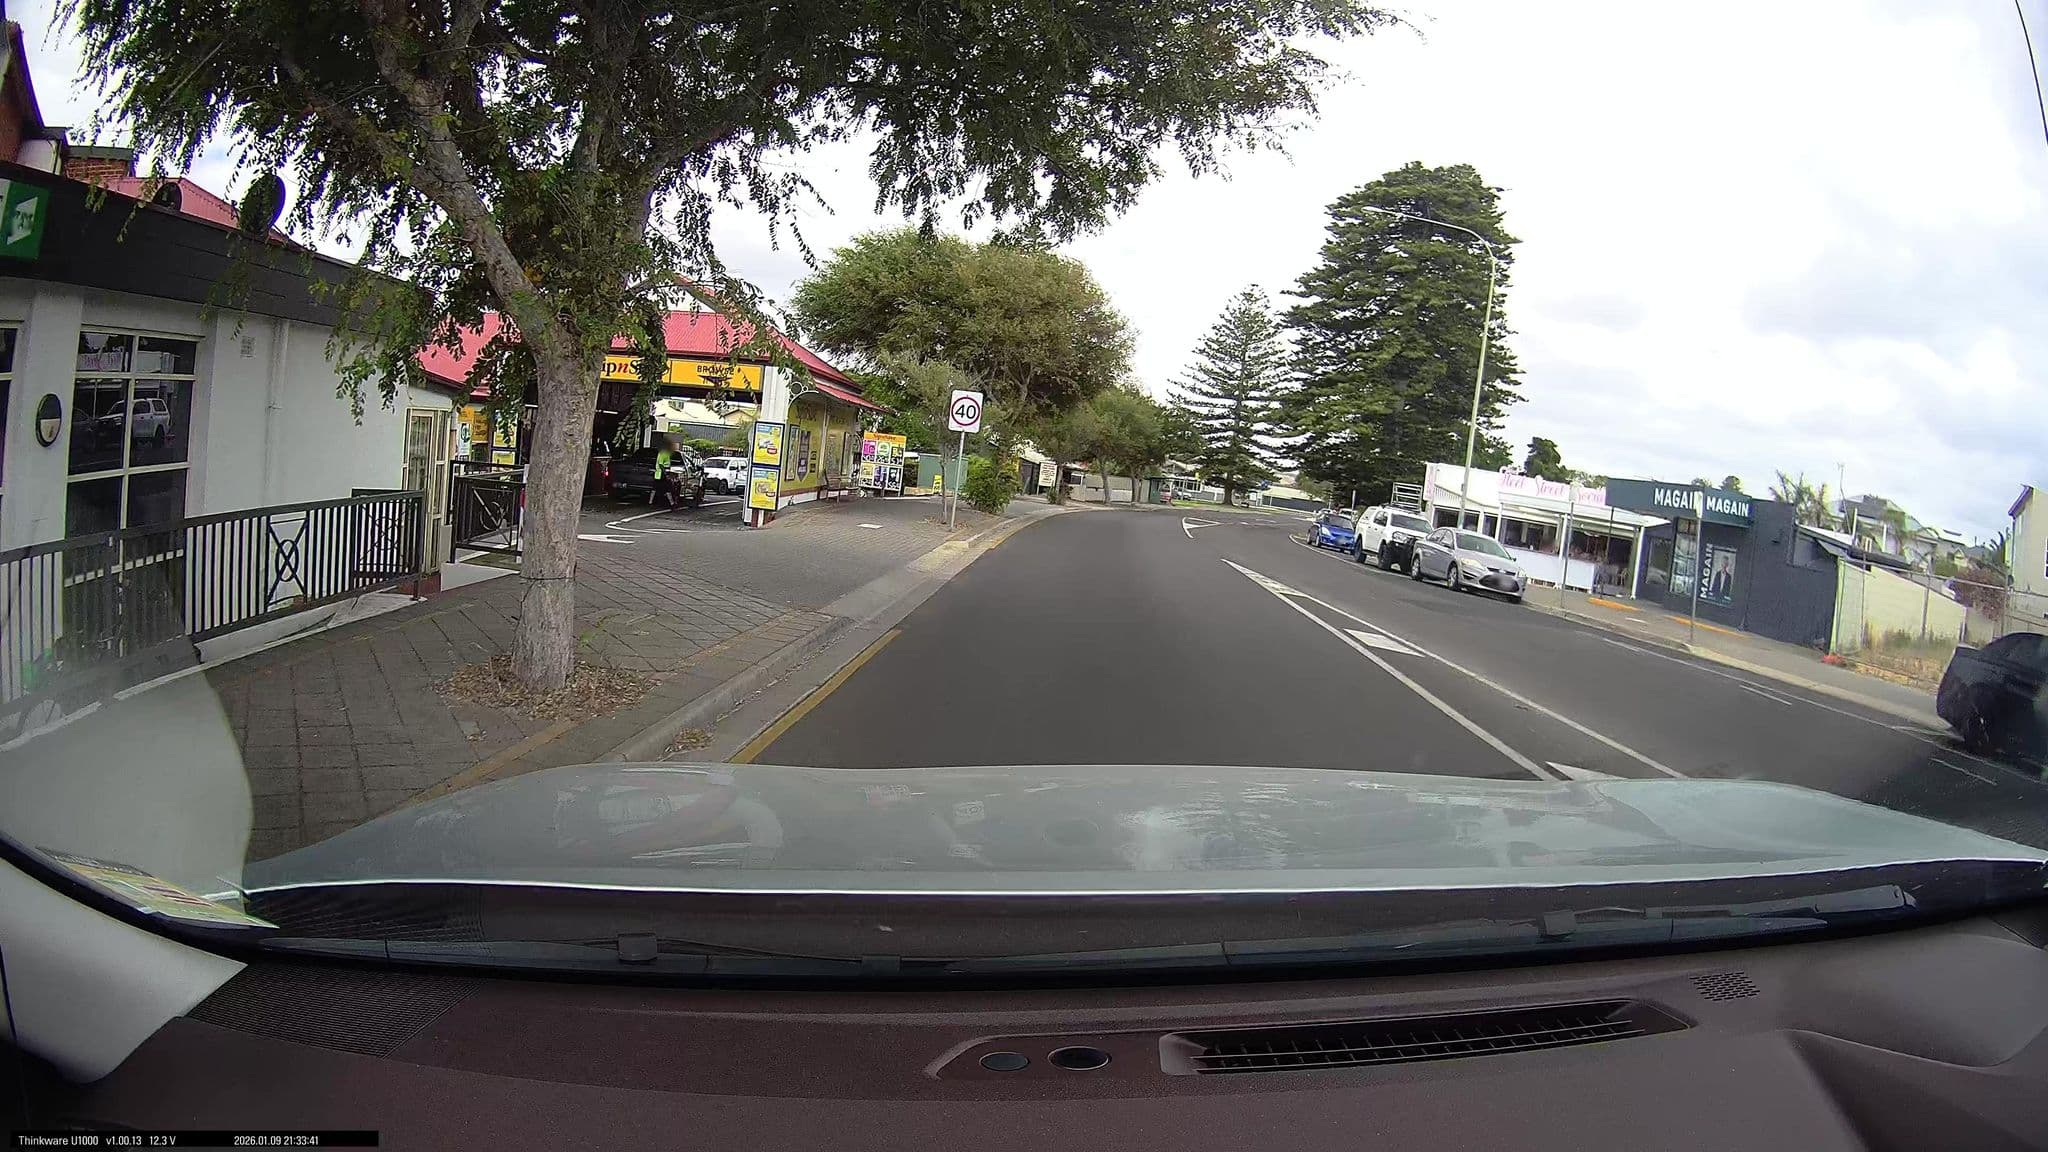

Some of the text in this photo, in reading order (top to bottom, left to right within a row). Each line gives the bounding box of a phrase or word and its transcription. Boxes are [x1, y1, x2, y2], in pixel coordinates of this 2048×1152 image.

[955, 404, 976, 420] 40
[1706, 496, 1749, 517] MAGAIN
[1700, 543, 1713, 598] MAGAIN
